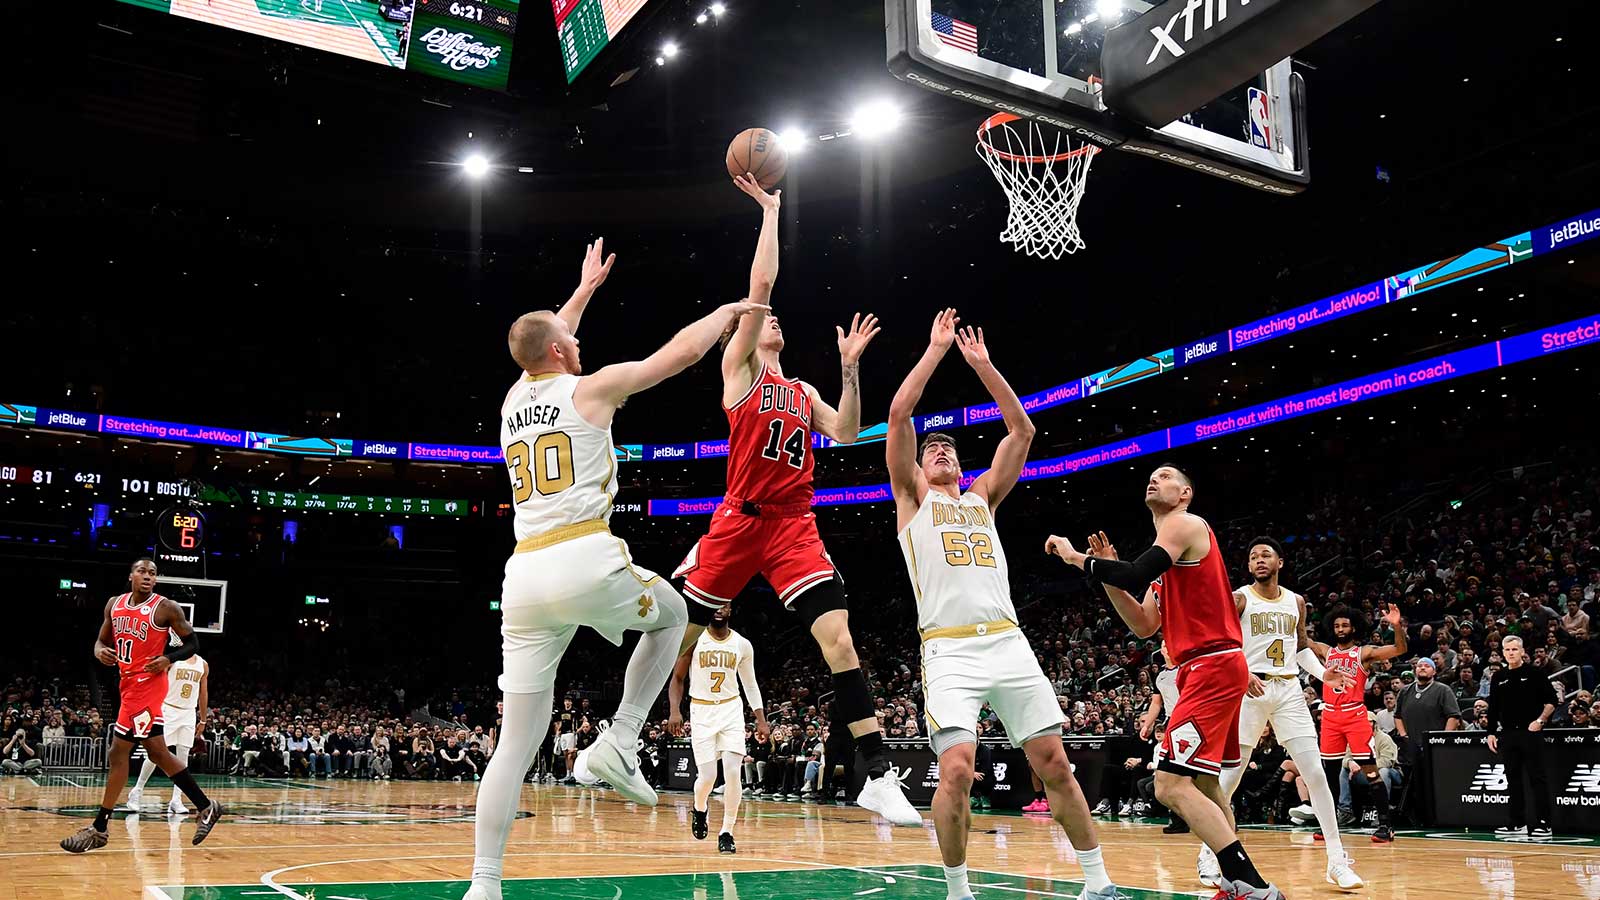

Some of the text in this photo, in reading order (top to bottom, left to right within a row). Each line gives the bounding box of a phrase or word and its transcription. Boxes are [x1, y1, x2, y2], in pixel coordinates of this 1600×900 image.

[450, 2, 483, 21] 6:21
[419, 27, 502, 59] Different
[427, 43, 491, 71] Here
[1550, 218, 1600, 248] jetBlue
[1235, 316, 1296, 344] Stretching
[1184, 341, 1218, 363] jetBlue
[759, 384, 811, 426] BULL
[1195, 417, 1235, 437] Stretch
[1237, 412, 1256, 427] out
[1257, 405, 1283, 421] with
[1284, 400, 1304, 415] the
[1306, 391, 1337, 409] most
[1339, 379, 1393, 402] legroom
[1394, 373, 1407, 387] in
[1408, 361, 1456, 383] coach.
[48, 412, 87, 426] jetBlue
[105, 418, 167, 437] Stretching
[507, 405, 560, 436] HAUSER
[924, 415, 954, 431] jetBlue
[363, 443, 397, 455] jetBlue
[700, 444, 730, 455] Stretc
[762, 418, 806, 470] 14
[414, 446, 469, 461] Stretching
[653, 447, 685, 460] jetBlue
[1039, 463, 1065, 475] most
[1065, 454, 1100, 471] legroom
[1101, 450, 1110, 461] in
[1110, 442, 1142, 459] coach.
[0, 466, 17, 481] GO
[32, 469, 52, 484] 81
[506, 431, 575, 505] 30
[74, 472, 101, 484] 6:21
[122, 478, 150, 494] 101
[252, 496, 258, 504] 2
[269, 497, 275, 505] 3
[336, 501, 357, 510] 17/47
[368, 503, 373, 511] 5
[421, 505, 430, 513] 51
[810, 488, 889, 506] groom in coach.
[627, 504, 641, 512] PM
[678, 501, 714, 512] Stretch
[173, 515, 199, 529] 6:20
[932, 501, 992, 531] BOSTON
[181, 528, 195, 548] 6
[170, 554, 200, 563] TISSOT
[941, 531, 997, 568] 52
[1250, 612, 1297, 638] BOSTON
[117, 638, 133, 664] 11
[699, 650, 737, 670] BOSTON
[1266, 639, 1284, 667] 4
[180, 683, 193, 699] 9
[710, 672, 725, 692] 7
[1428, 736, 1446, 744] xfinity
[1454, 736, 1472, 744] xfinity
[1564, 735, 1585, 743] xfinity
[1461, 794, 1481, 803] new
[1556, 795, 1600, 806] new bal
